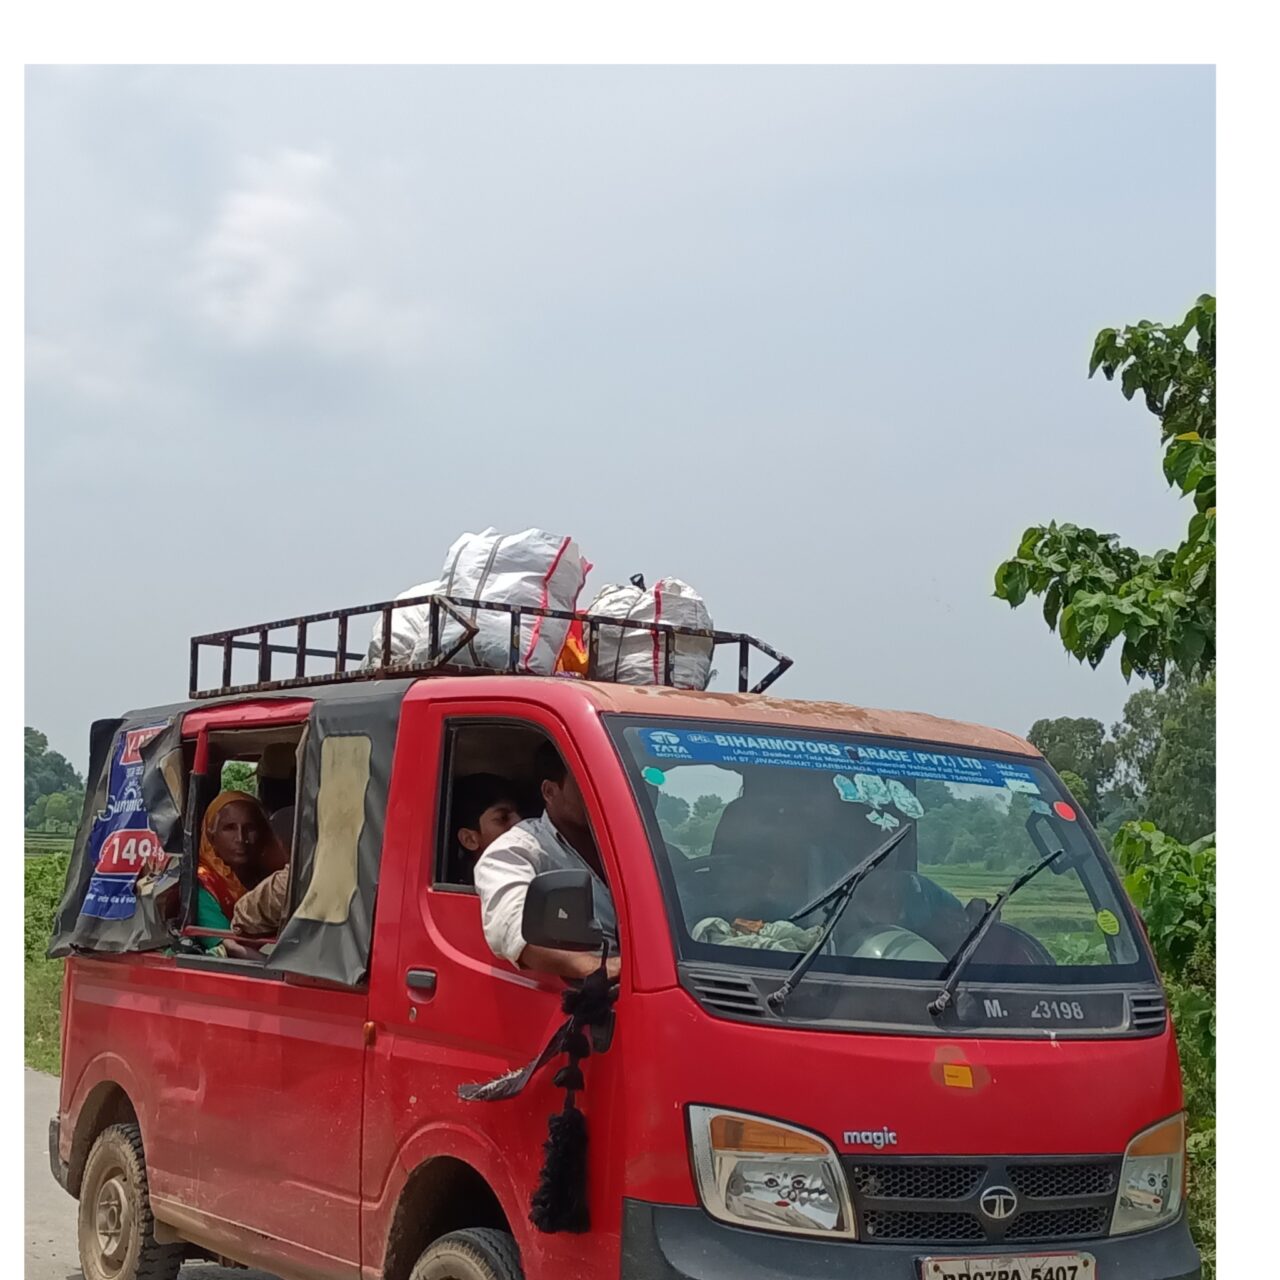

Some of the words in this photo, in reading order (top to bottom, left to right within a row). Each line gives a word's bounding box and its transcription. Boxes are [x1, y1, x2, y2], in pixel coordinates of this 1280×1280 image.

[651, 744, 689, 754] TATA
[714, 734, 841, 756] BIHARMOTORS
[913, 751, 957, 769] (PVT.)
[958, 757, 987, 770] LTD.
[97, 795, 147, 822] Summe
[111, 838, 152, 867] 149
[843, 1126, 898, 1150] magic
